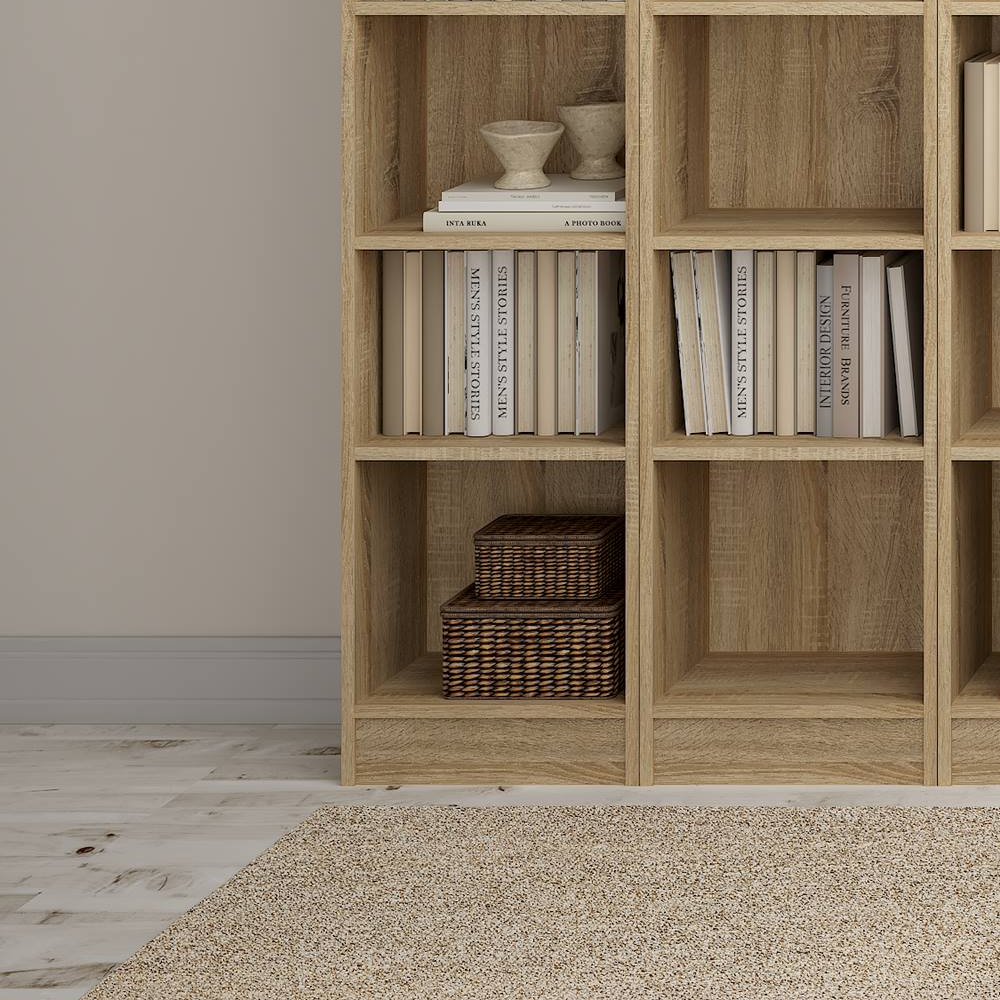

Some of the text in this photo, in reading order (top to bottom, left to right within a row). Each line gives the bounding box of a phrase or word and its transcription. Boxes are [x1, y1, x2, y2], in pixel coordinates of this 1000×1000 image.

[471, 268, 480, 421] MEN'S STYLE STORIES
[498, 265, 508, 419] MEN'S STYLE STORIES
[737, 265, 747, 418] MEN'S STYLE STORIES
[819, 295, 832, 409] INTERIOR DESIGN
[841, 285, 852, 406] FURNITURE BRANDS
